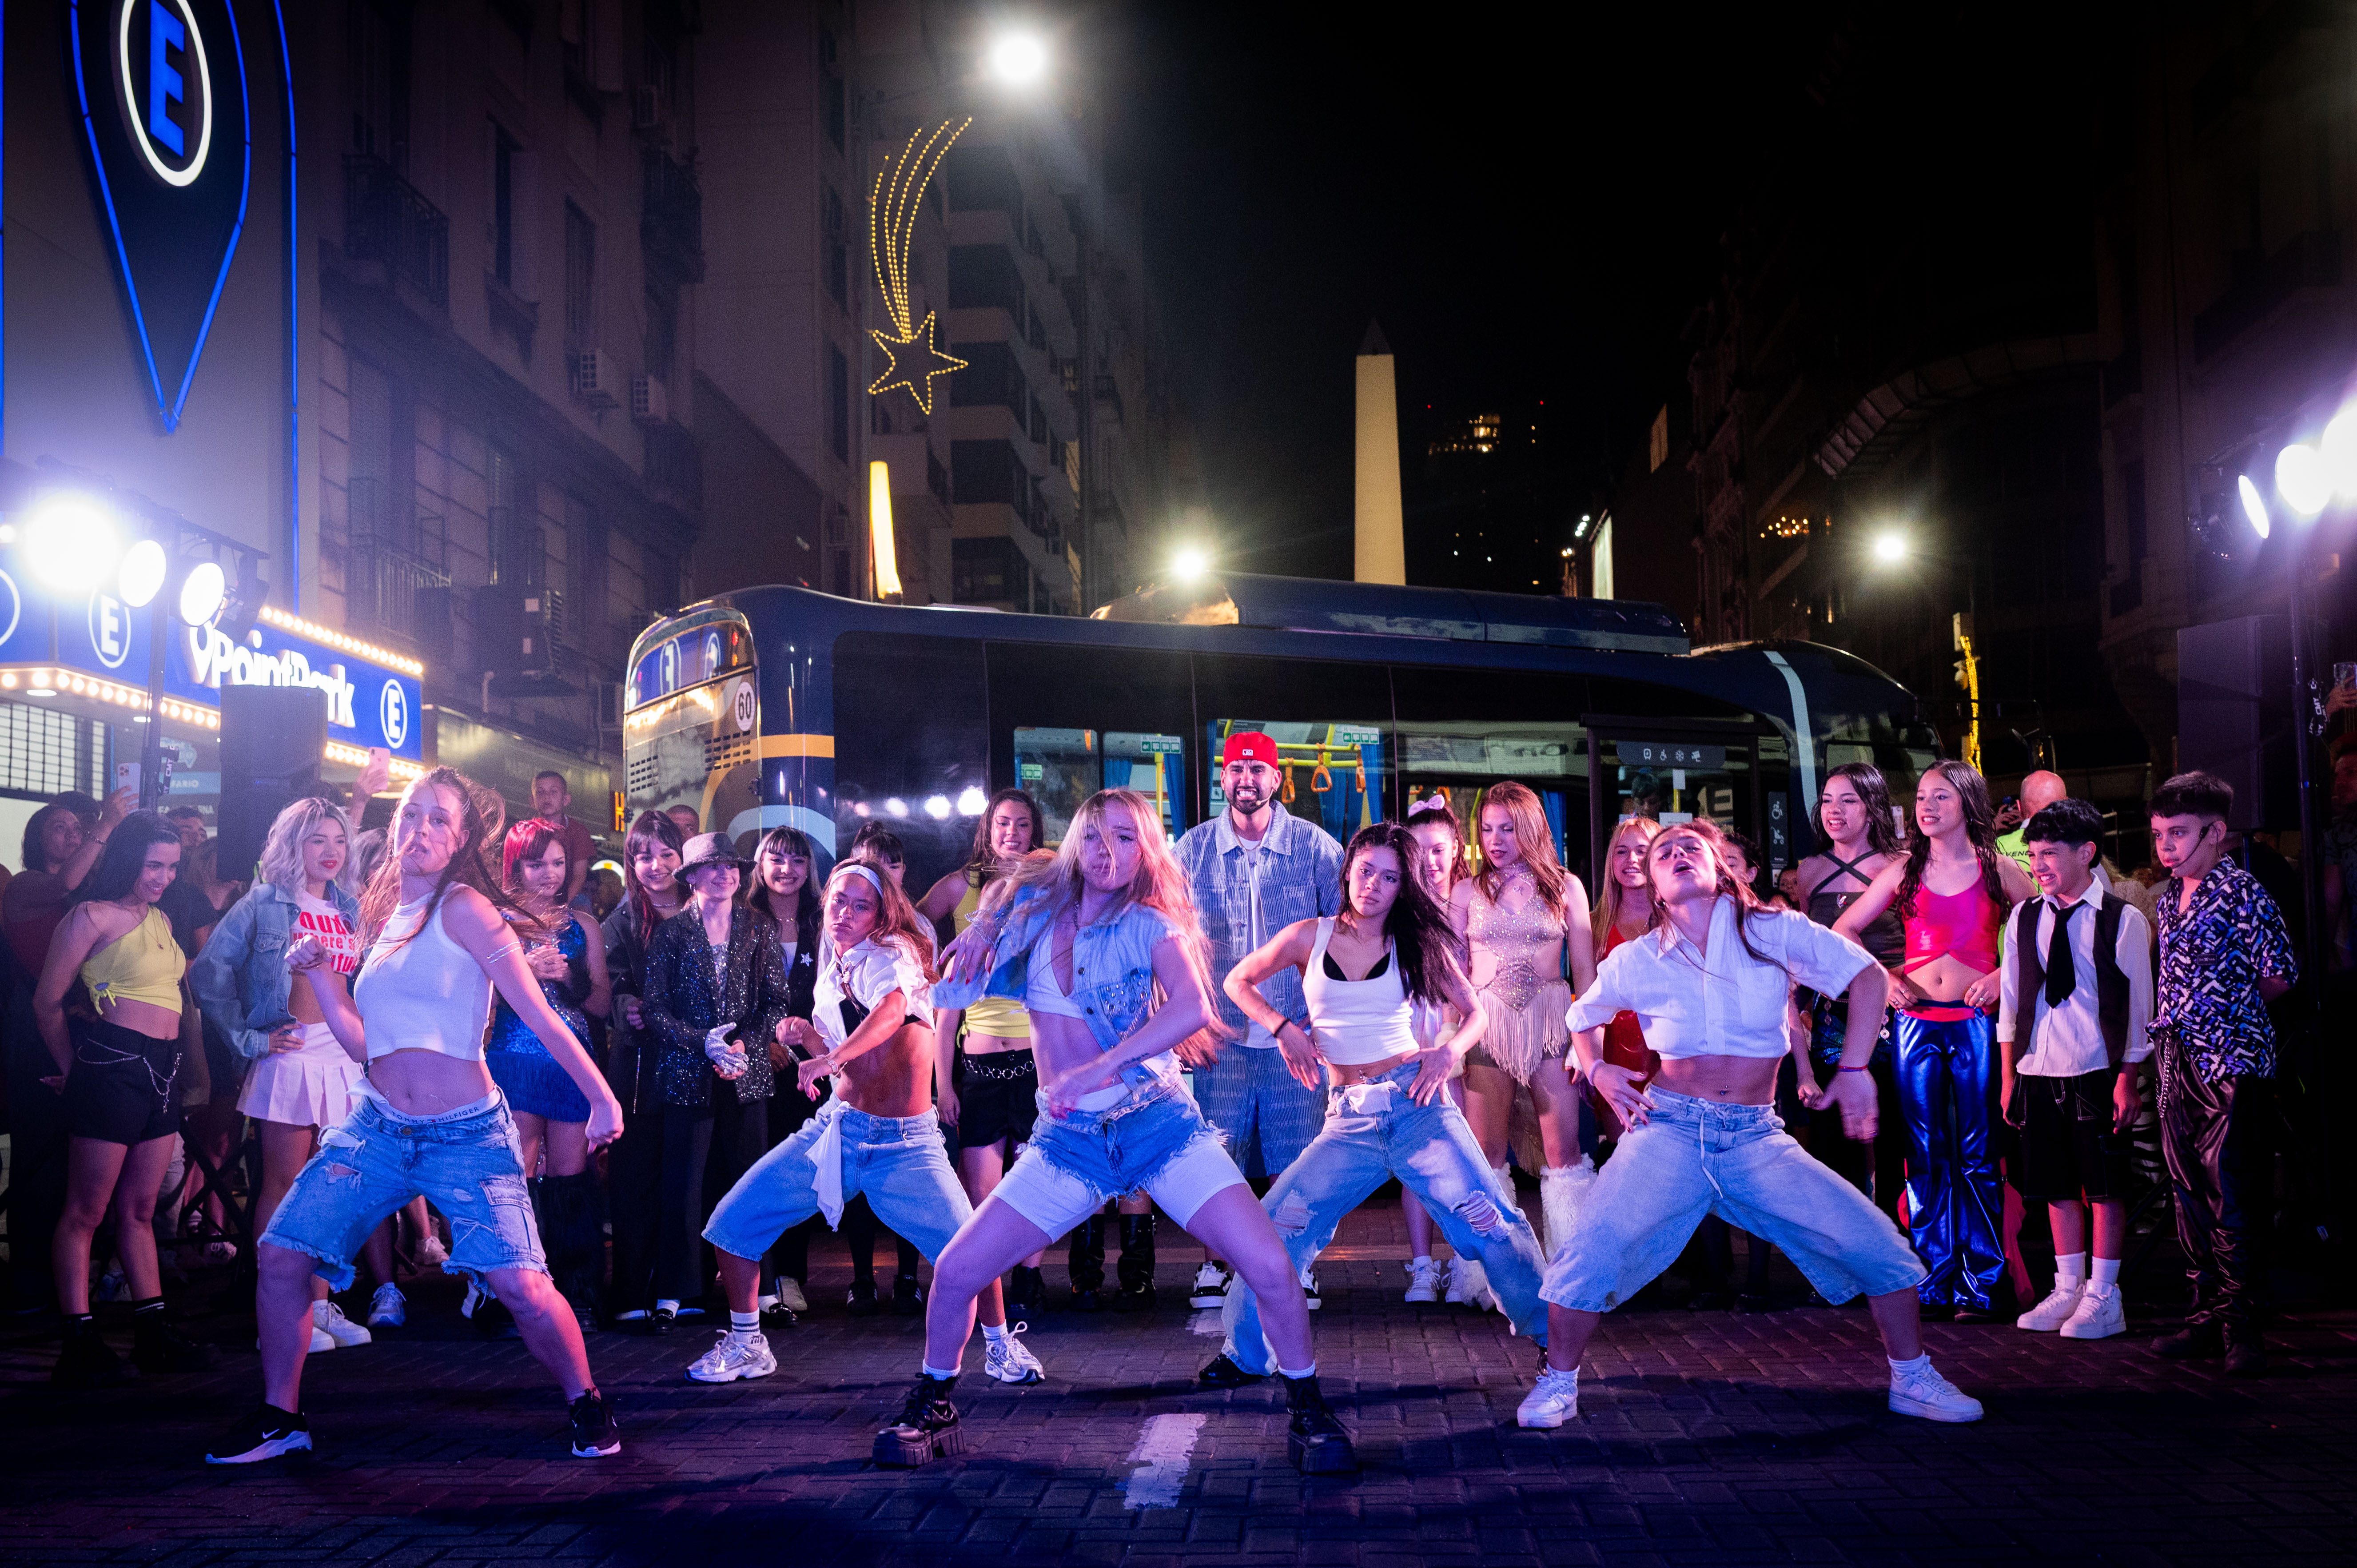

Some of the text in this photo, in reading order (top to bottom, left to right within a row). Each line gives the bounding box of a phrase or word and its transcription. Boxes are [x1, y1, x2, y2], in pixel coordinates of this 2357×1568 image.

[150, 0, 184, 157] E
[100, 593, 119, 657] E
[387, 688, 401, 739] E
[738, 691, 752, 720] 60
[2313, 697, 2322, 716] CMY
[391, 1106, 479, 1124] TOMMY HILFIGER
